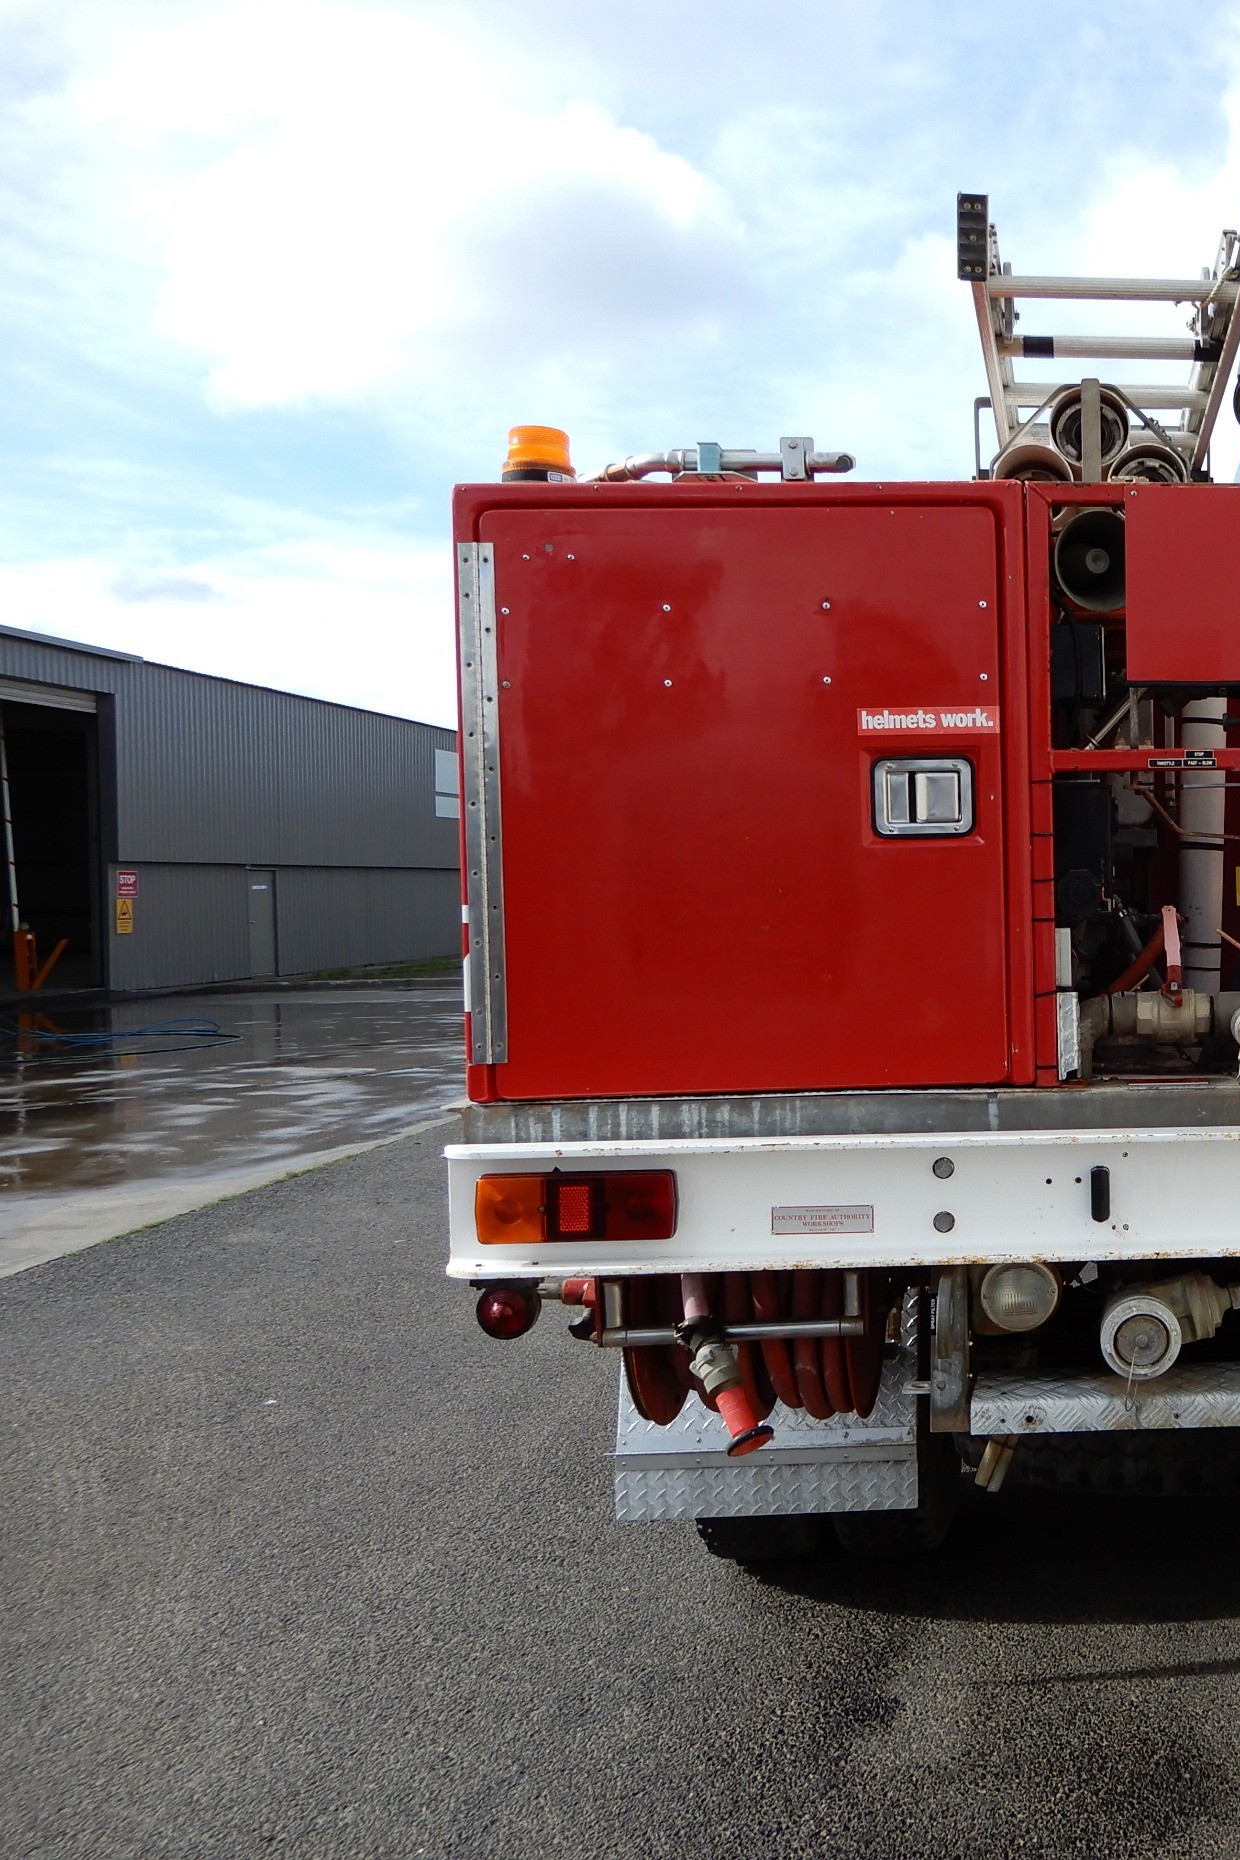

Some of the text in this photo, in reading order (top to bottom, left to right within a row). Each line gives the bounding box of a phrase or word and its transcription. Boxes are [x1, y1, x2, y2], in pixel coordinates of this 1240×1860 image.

[861, 708, 994, 729] helmets work.
[119, 875, 136, 884] STOP
